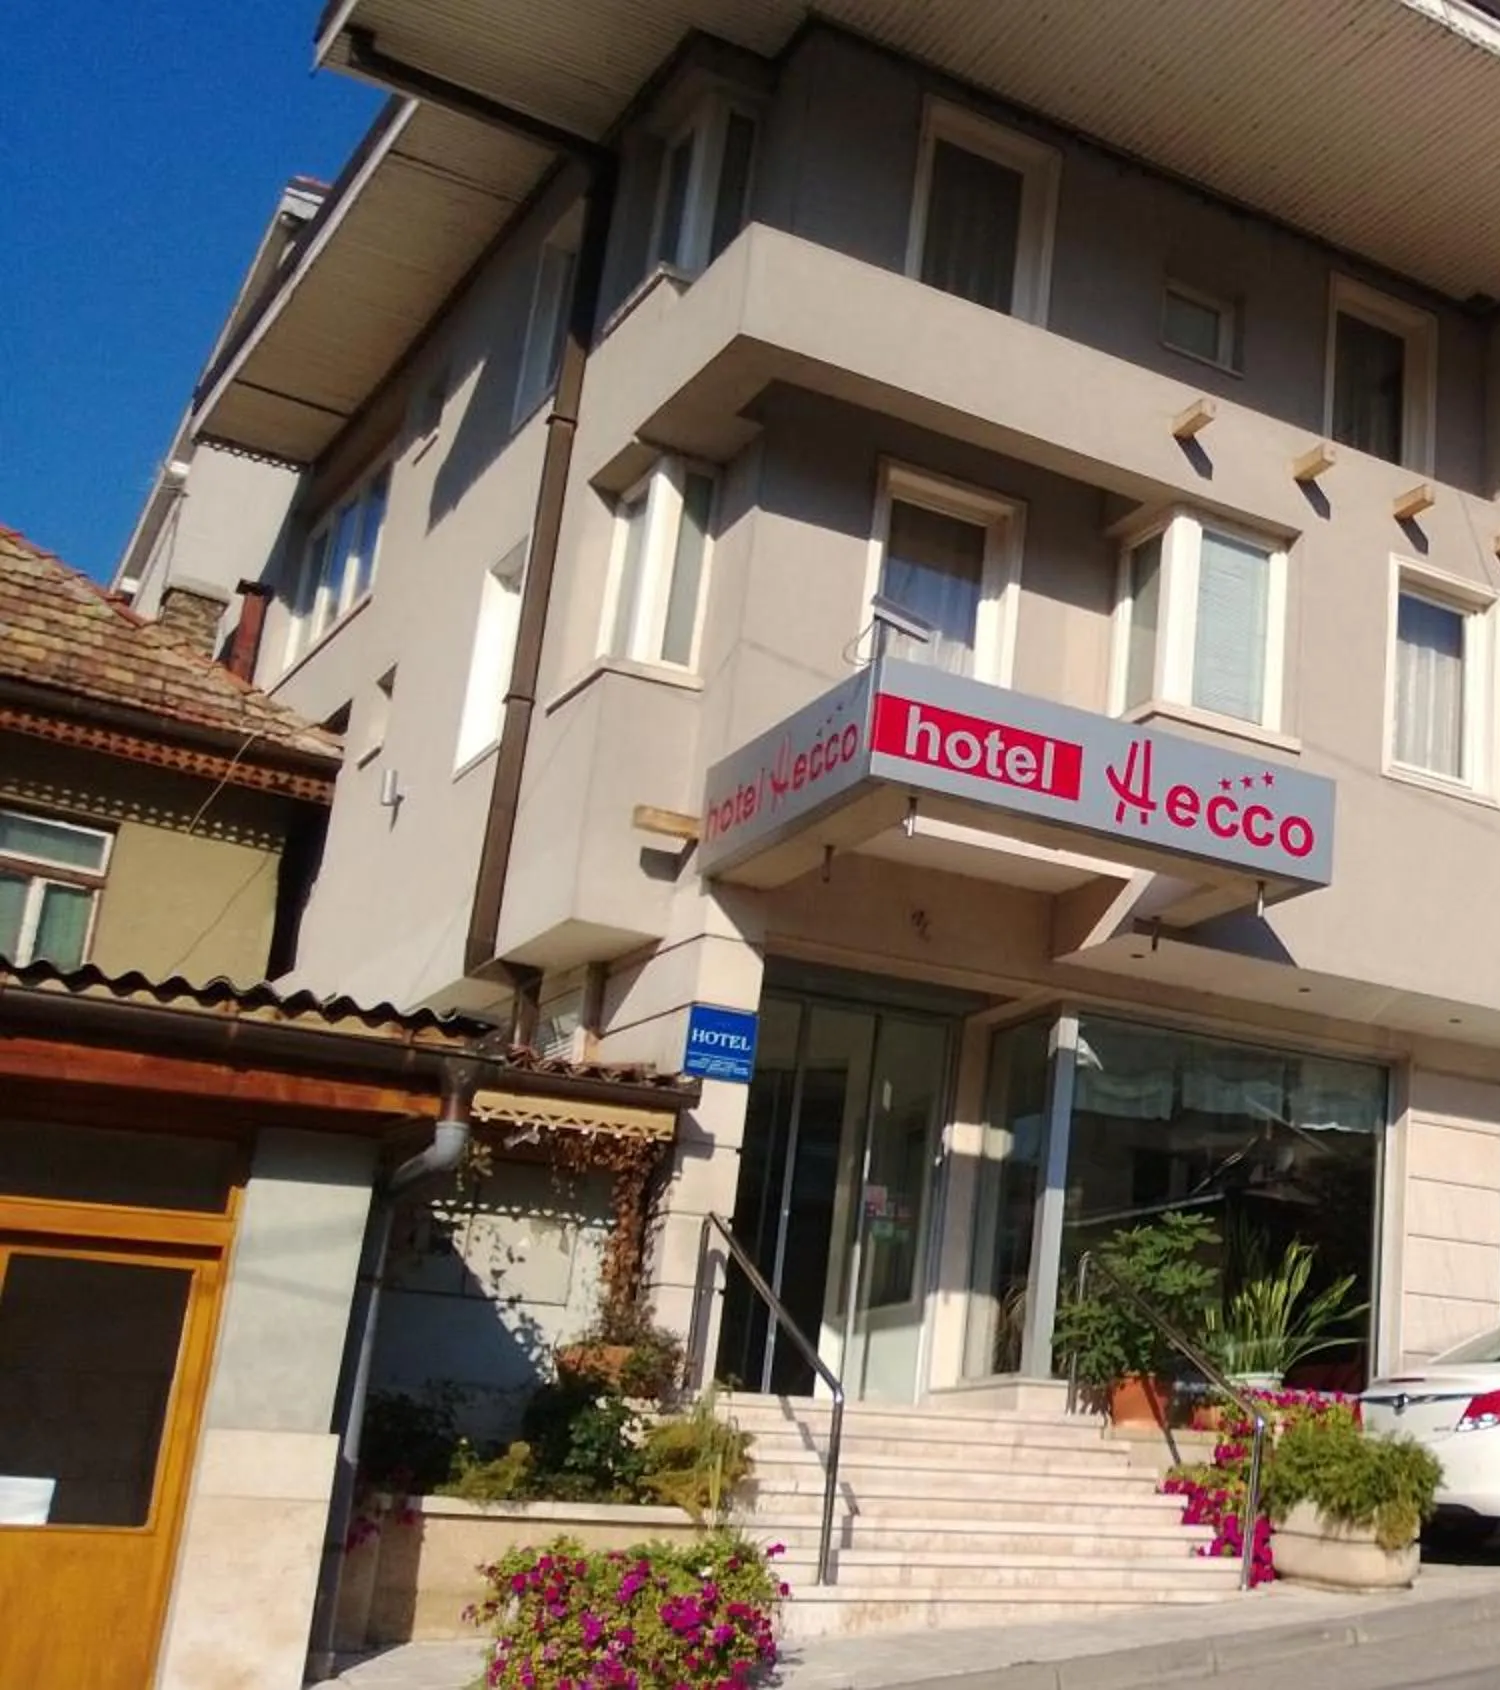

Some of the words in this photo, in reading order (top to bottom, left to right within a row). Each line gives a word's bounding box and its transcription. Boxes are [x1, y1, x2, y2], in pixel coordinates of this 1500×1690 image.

[705, 767, 765, 843] hotel
[905, 704, 1055, 790] hotel
[1105, 739, 1315, 858] Hecco
[691, 1027, 751, 1051] HOTEL
